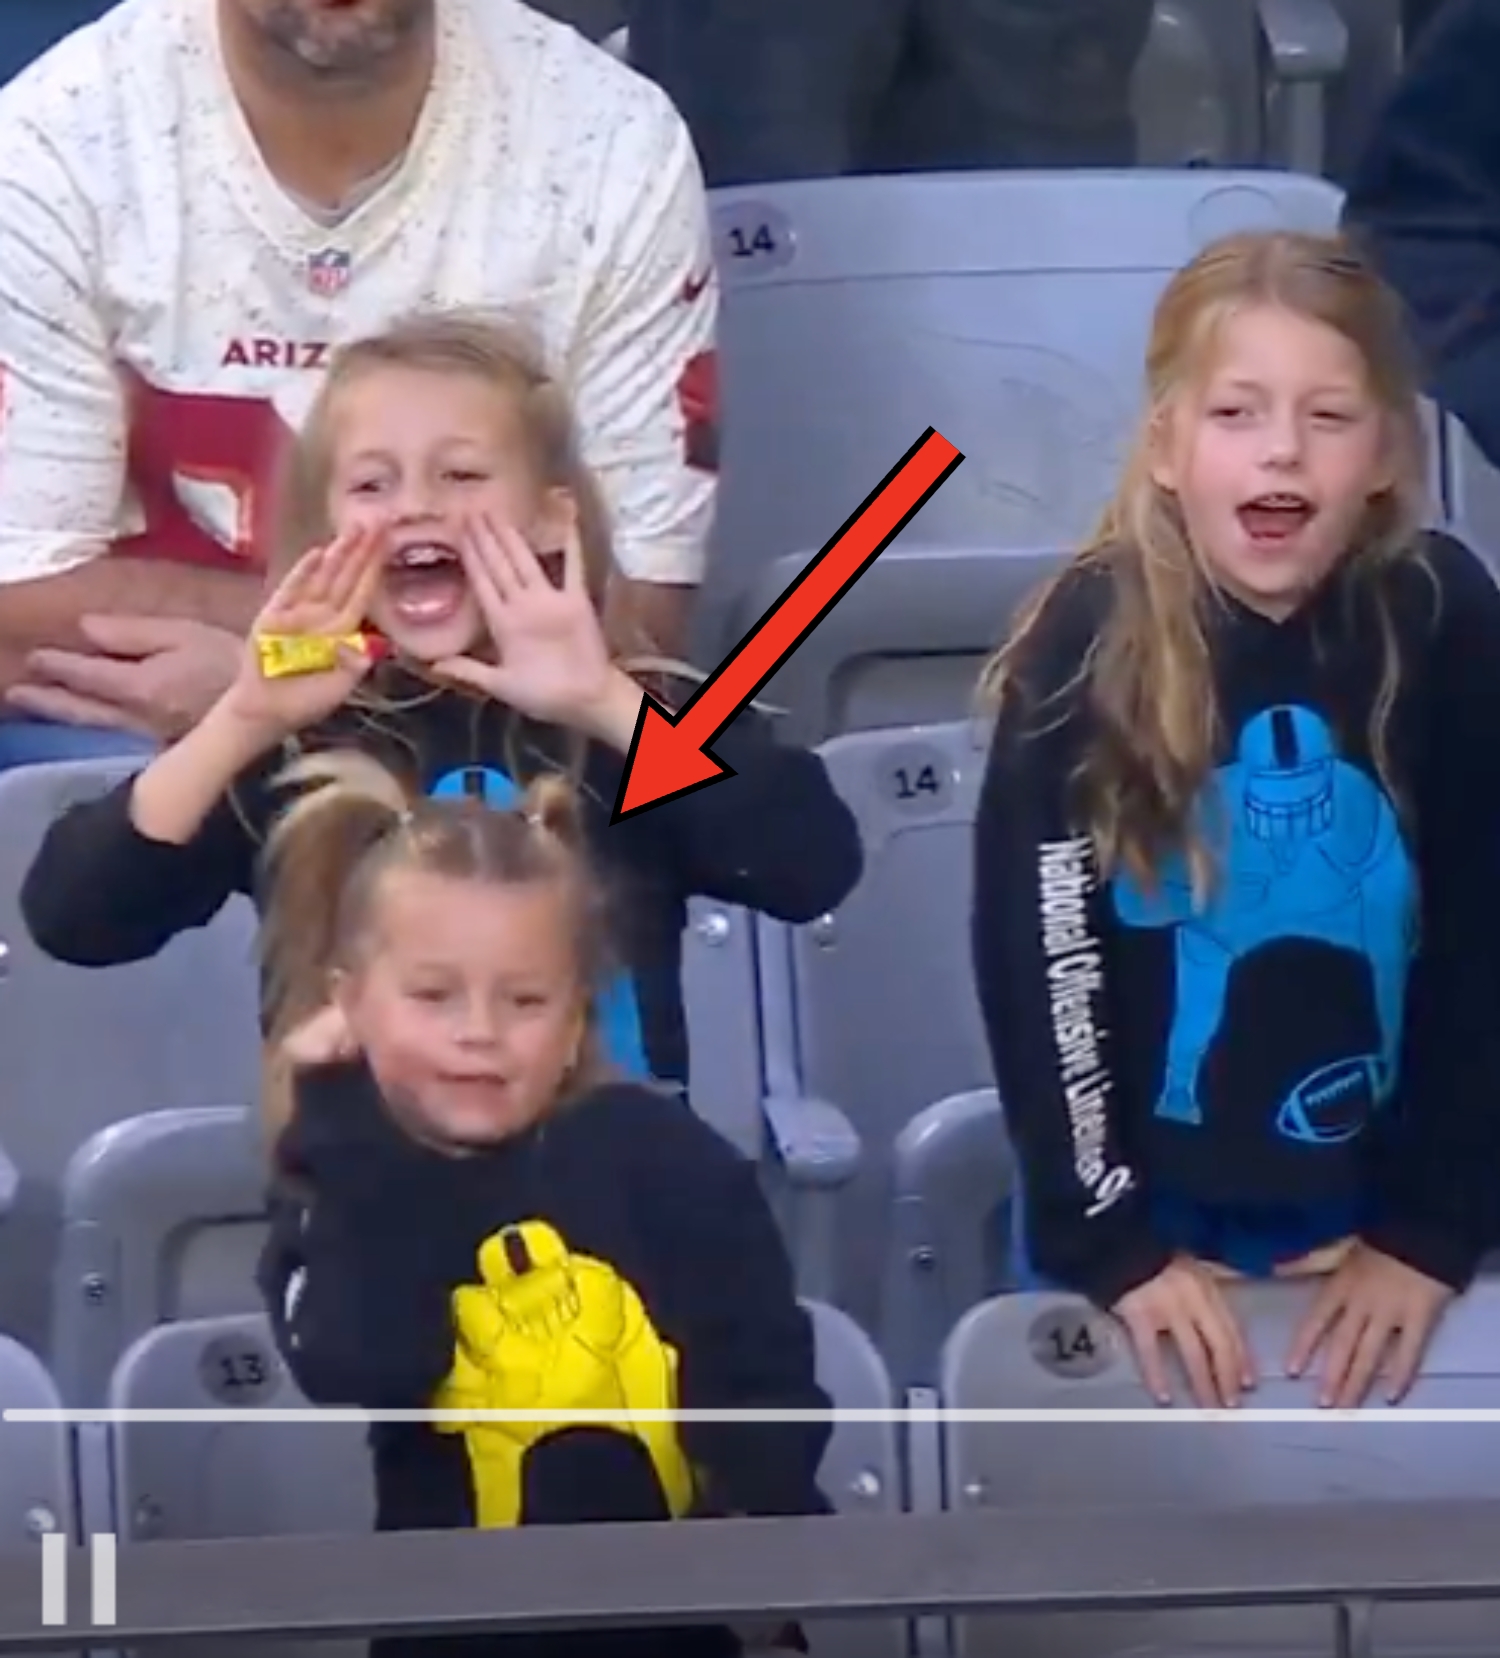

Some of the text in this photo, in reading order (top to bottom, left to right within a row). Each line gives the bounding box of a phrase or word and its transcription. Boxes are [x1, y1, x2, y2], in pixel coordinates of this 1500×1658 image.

[728, 223, 777, 258] 14
[895, 764, 938, 799] 14
[1036, 836, 1100, 957] National
[1048, 1323, 1095, 1361] 14
[221, 1354, 265, 1386] 13
